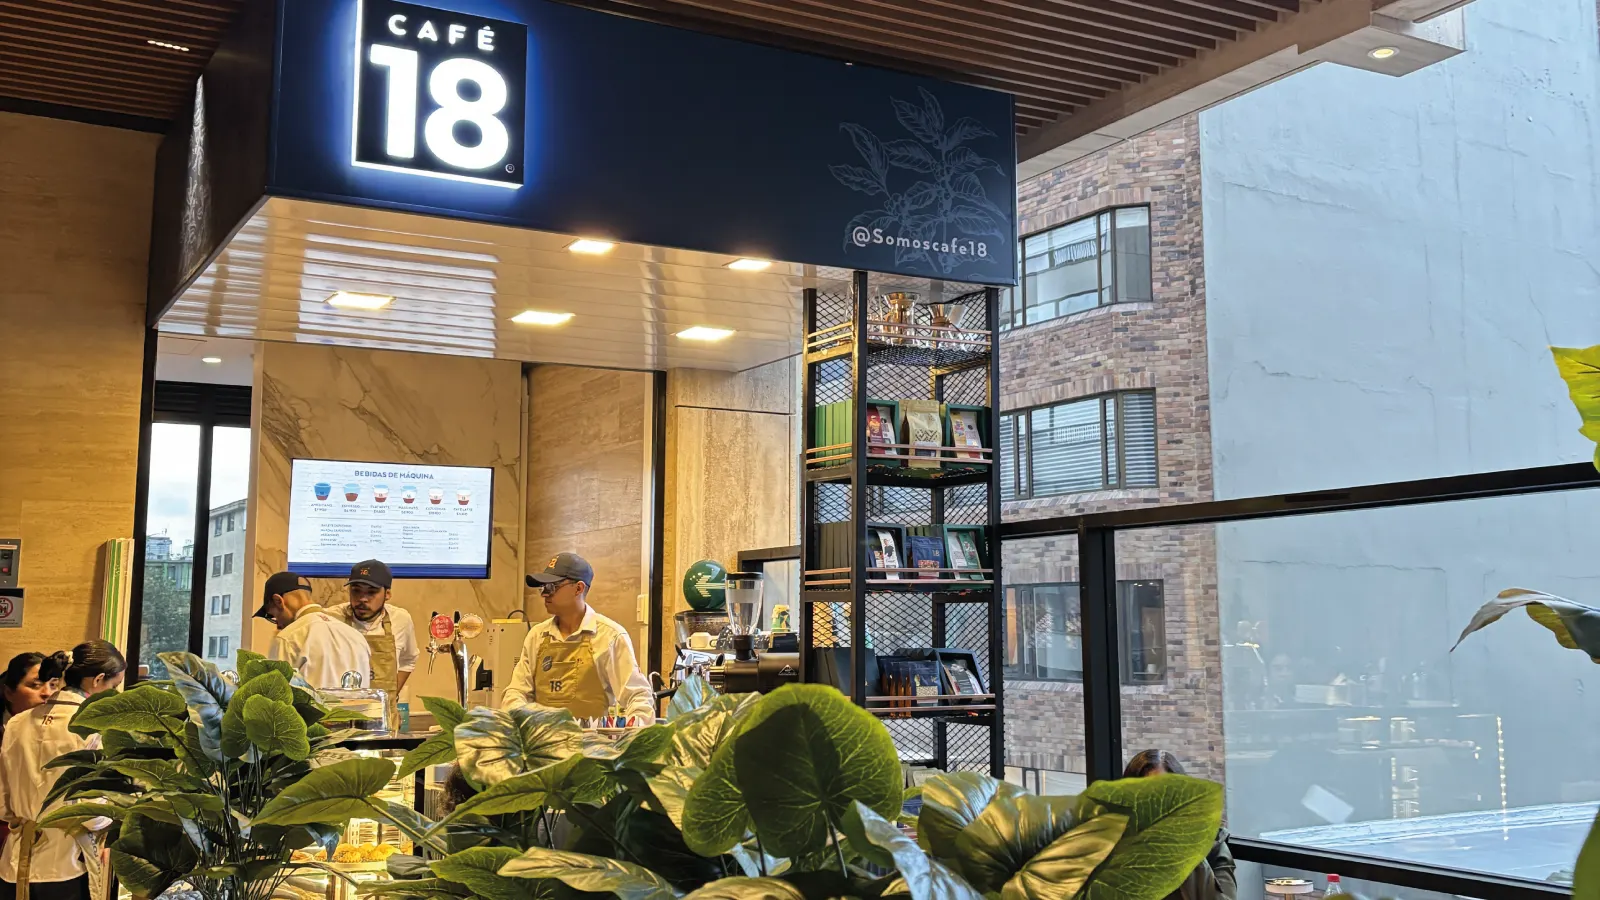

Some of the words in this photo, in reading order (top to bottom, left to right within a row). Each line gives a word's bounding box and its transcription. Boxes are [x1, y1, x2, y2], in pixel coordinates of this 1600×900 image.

[388, 14, 495, 51] CAFÉ
[370, 43, 509, 170] 18
[852, 226, 987, 257] @Somoscafe18
[354, 470, 387, 478] BEBIDAS
[399, 471, 434, 480] MÁQUINA
[549, 680, 563, 693] 18
